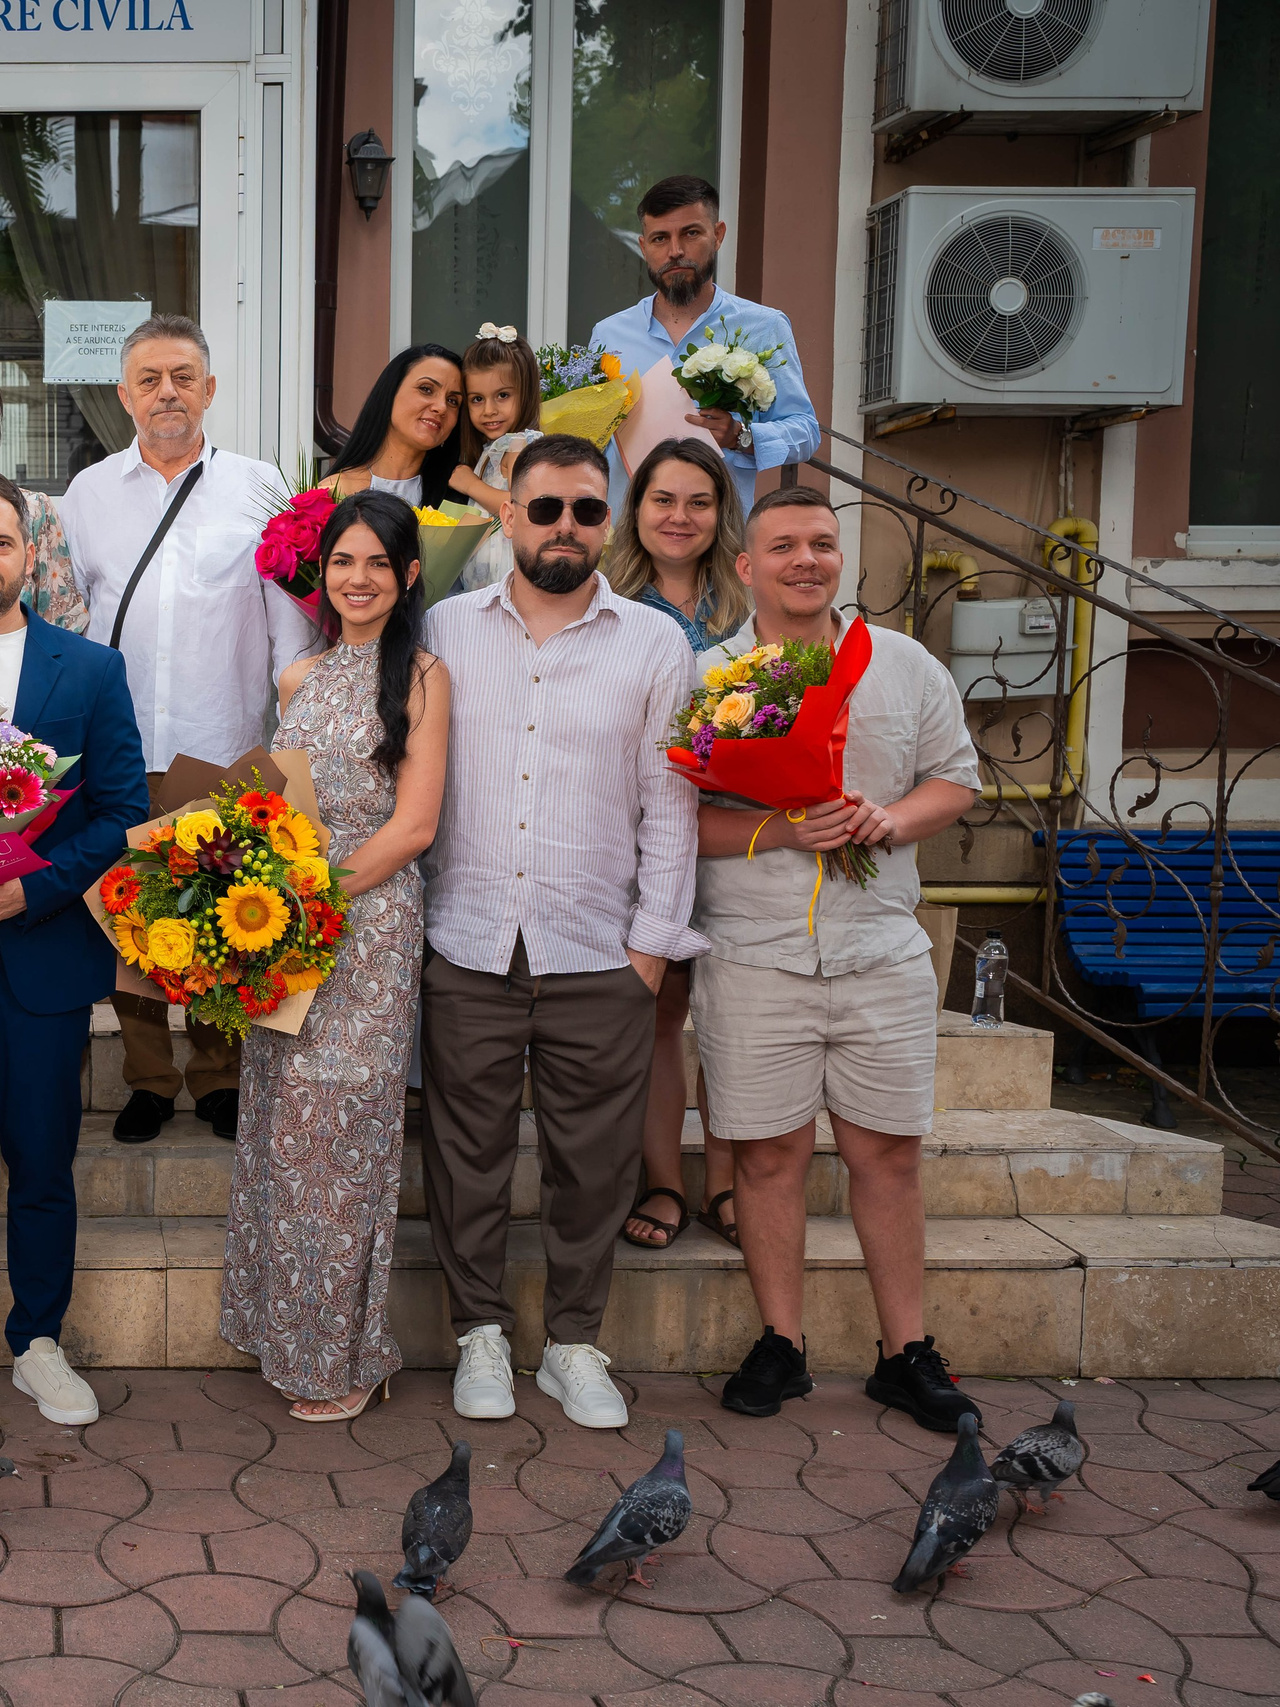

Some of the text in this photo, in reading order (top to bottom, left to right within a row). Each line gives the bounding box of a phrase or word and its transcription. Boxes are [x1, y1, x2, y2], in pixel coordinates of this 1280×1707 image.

[69, 324, 126, 332] ESTE INTERZIS
[78, 347, 117, 355] CONFETTI
